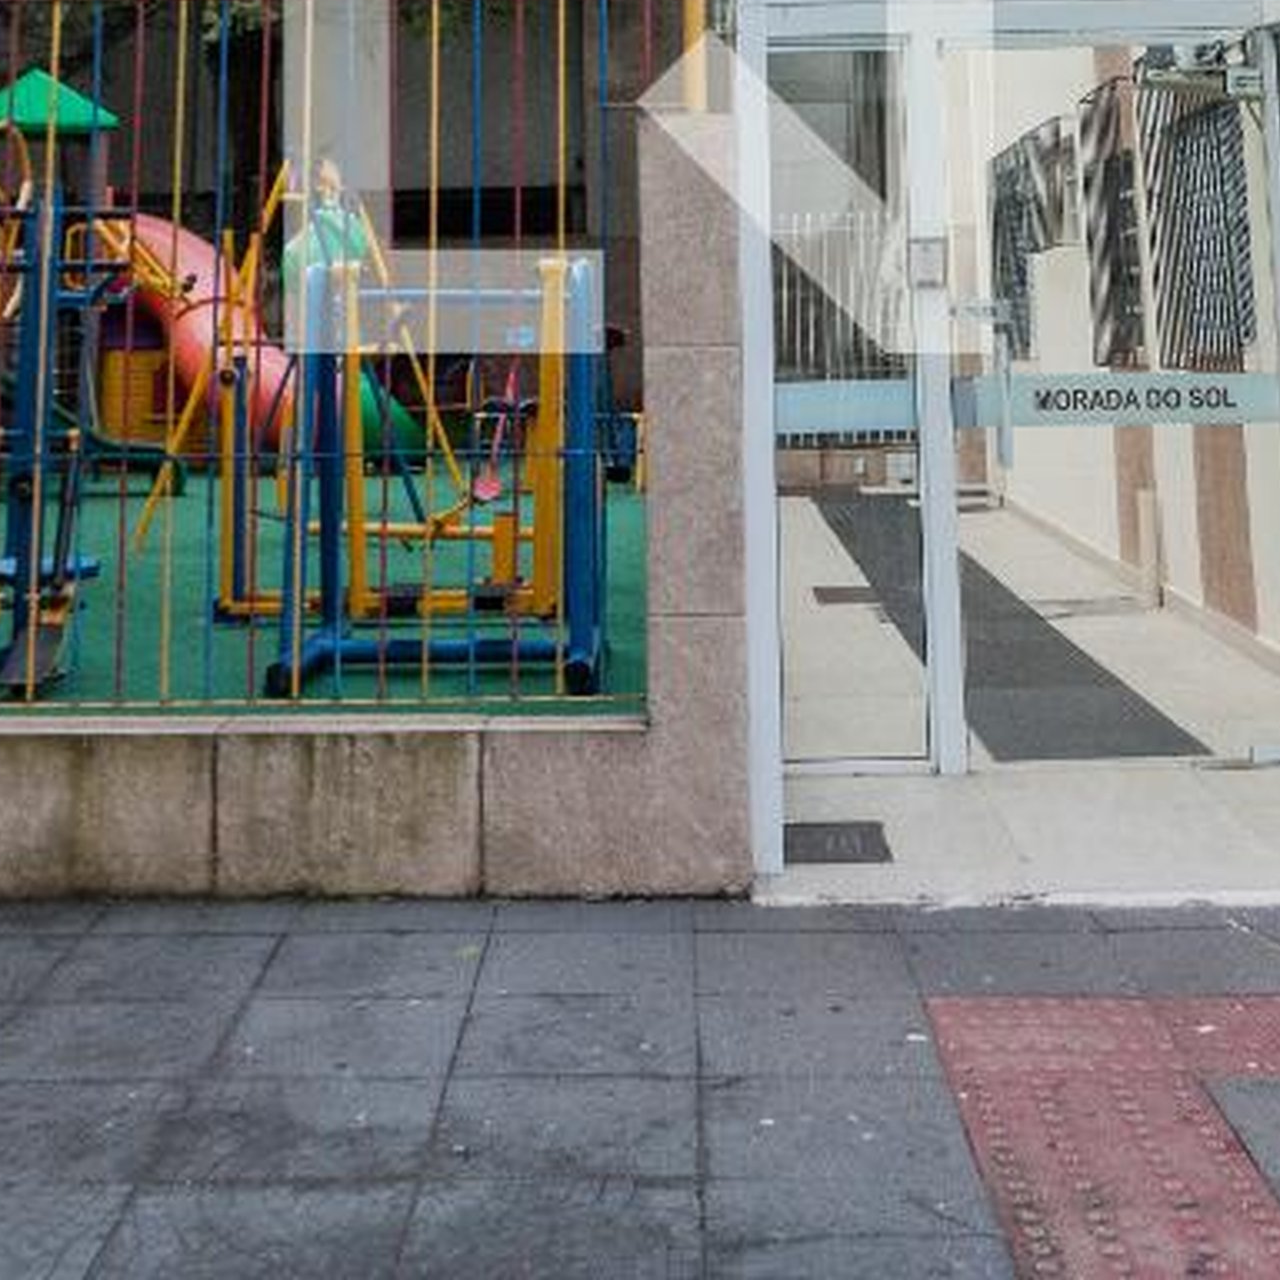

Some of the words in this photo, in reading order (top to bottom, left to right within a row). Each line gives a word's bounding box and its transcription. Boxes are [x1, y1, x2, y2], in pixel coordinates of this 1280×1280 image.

[1033, 387, 1141, 412] MORADA
[1146, 387, 1181, 410] DO
[1188, 385, 1238, 409] SOL
